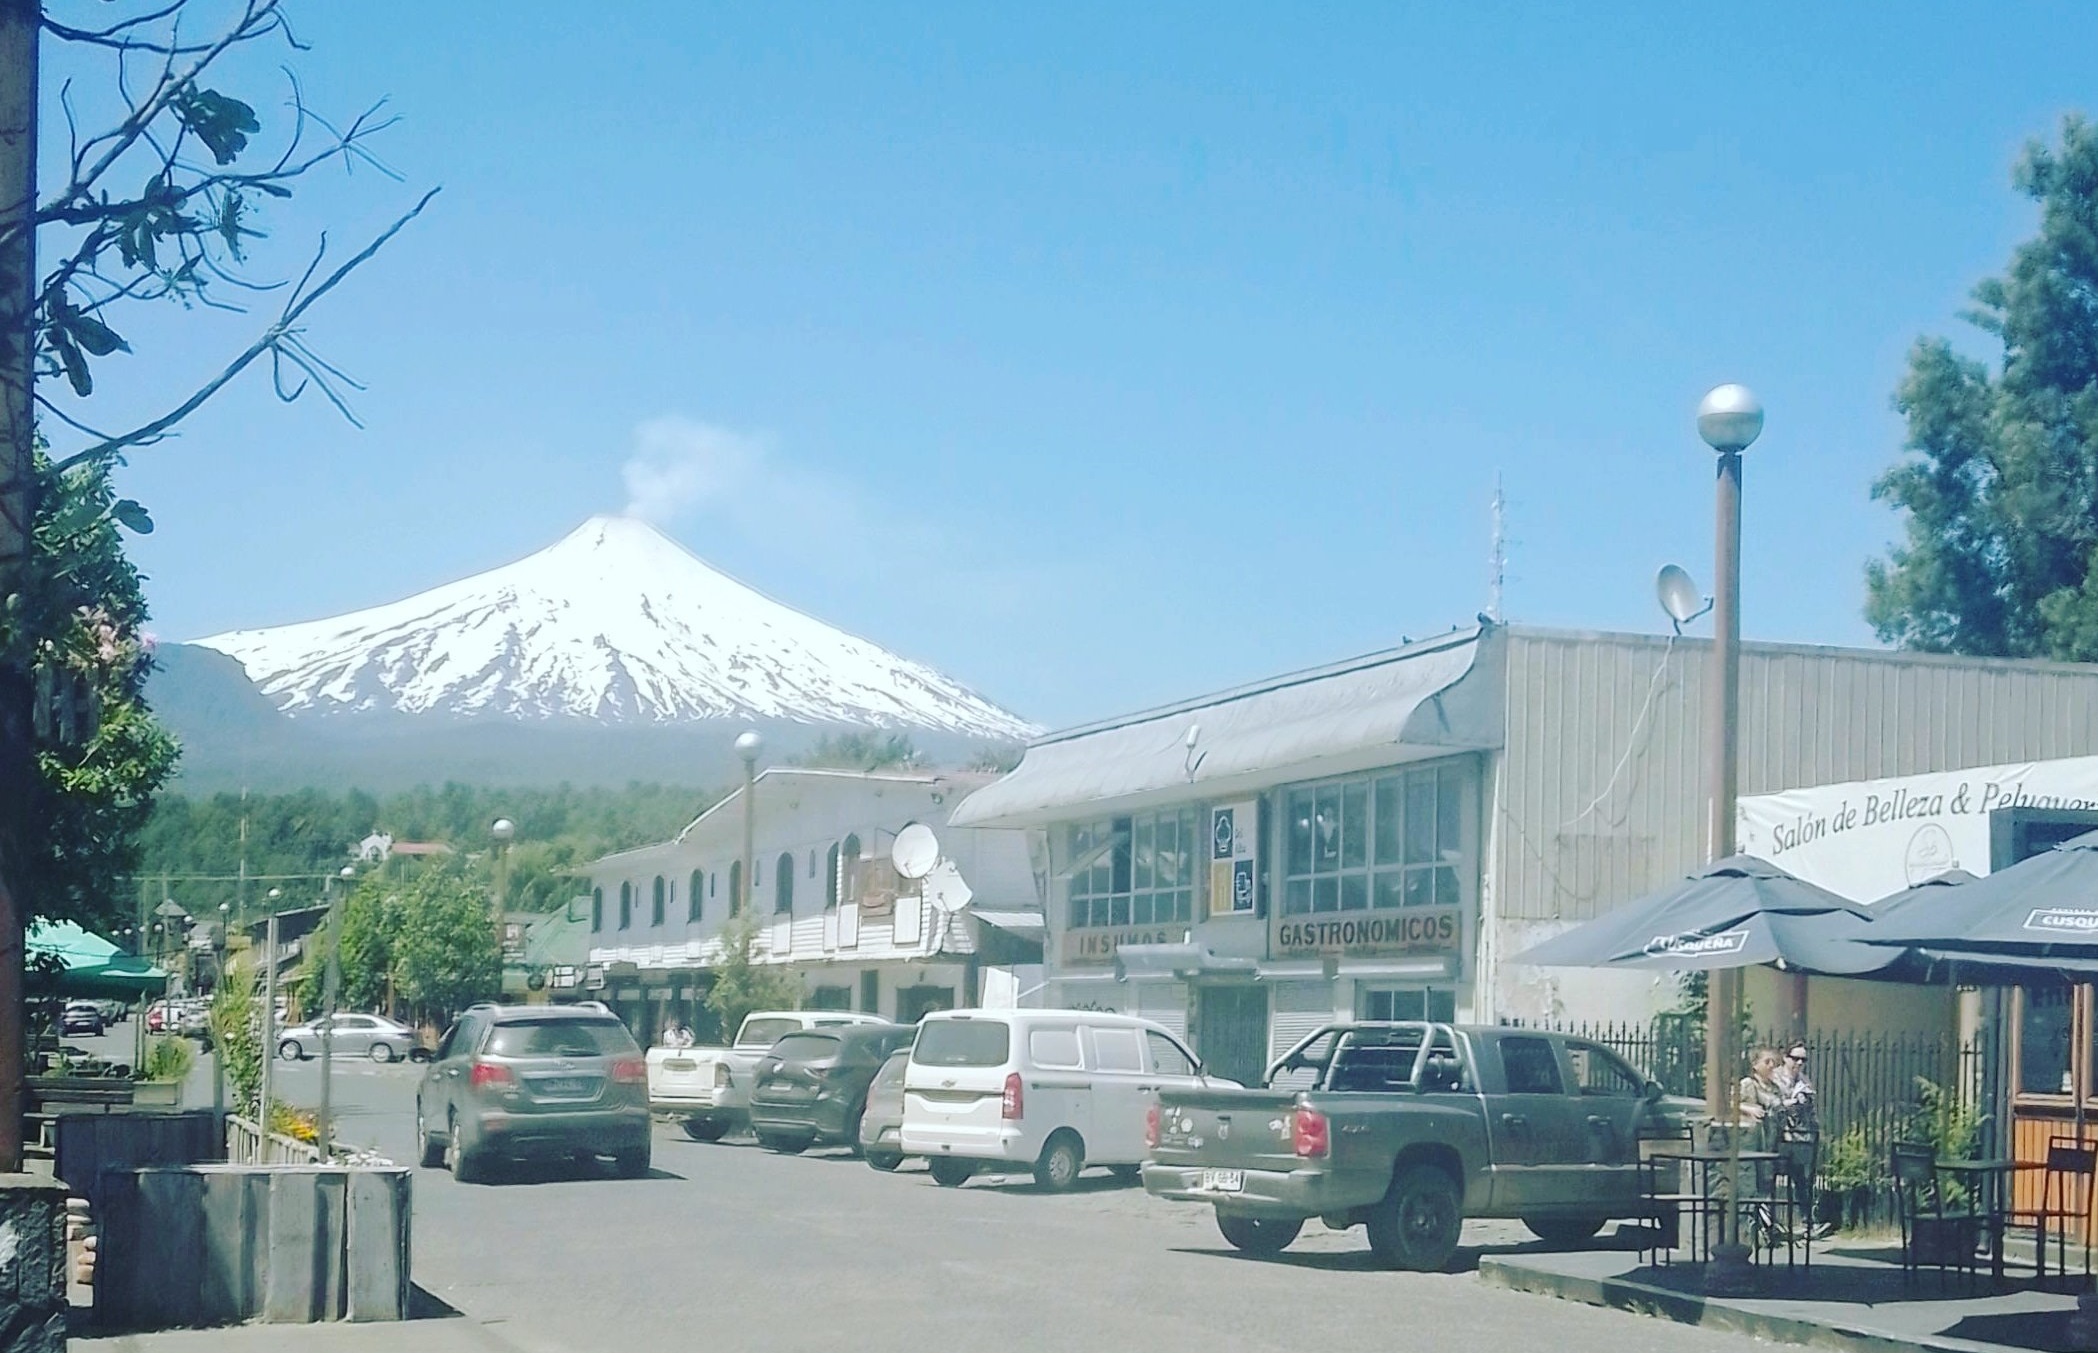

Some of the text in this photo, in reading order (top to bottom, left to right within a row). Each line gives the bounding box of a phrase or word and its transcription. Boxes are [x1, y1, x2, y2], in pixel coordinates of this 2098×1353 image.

[1772, 812, 1826, 856] Salón
[1833, 800, 1857, 834] de
[1862, 788, 1943, 826] Belleza
[1950, 782, 1971, 814] &
[1280, 915, 1453, 946] GASTRONOMICOS
